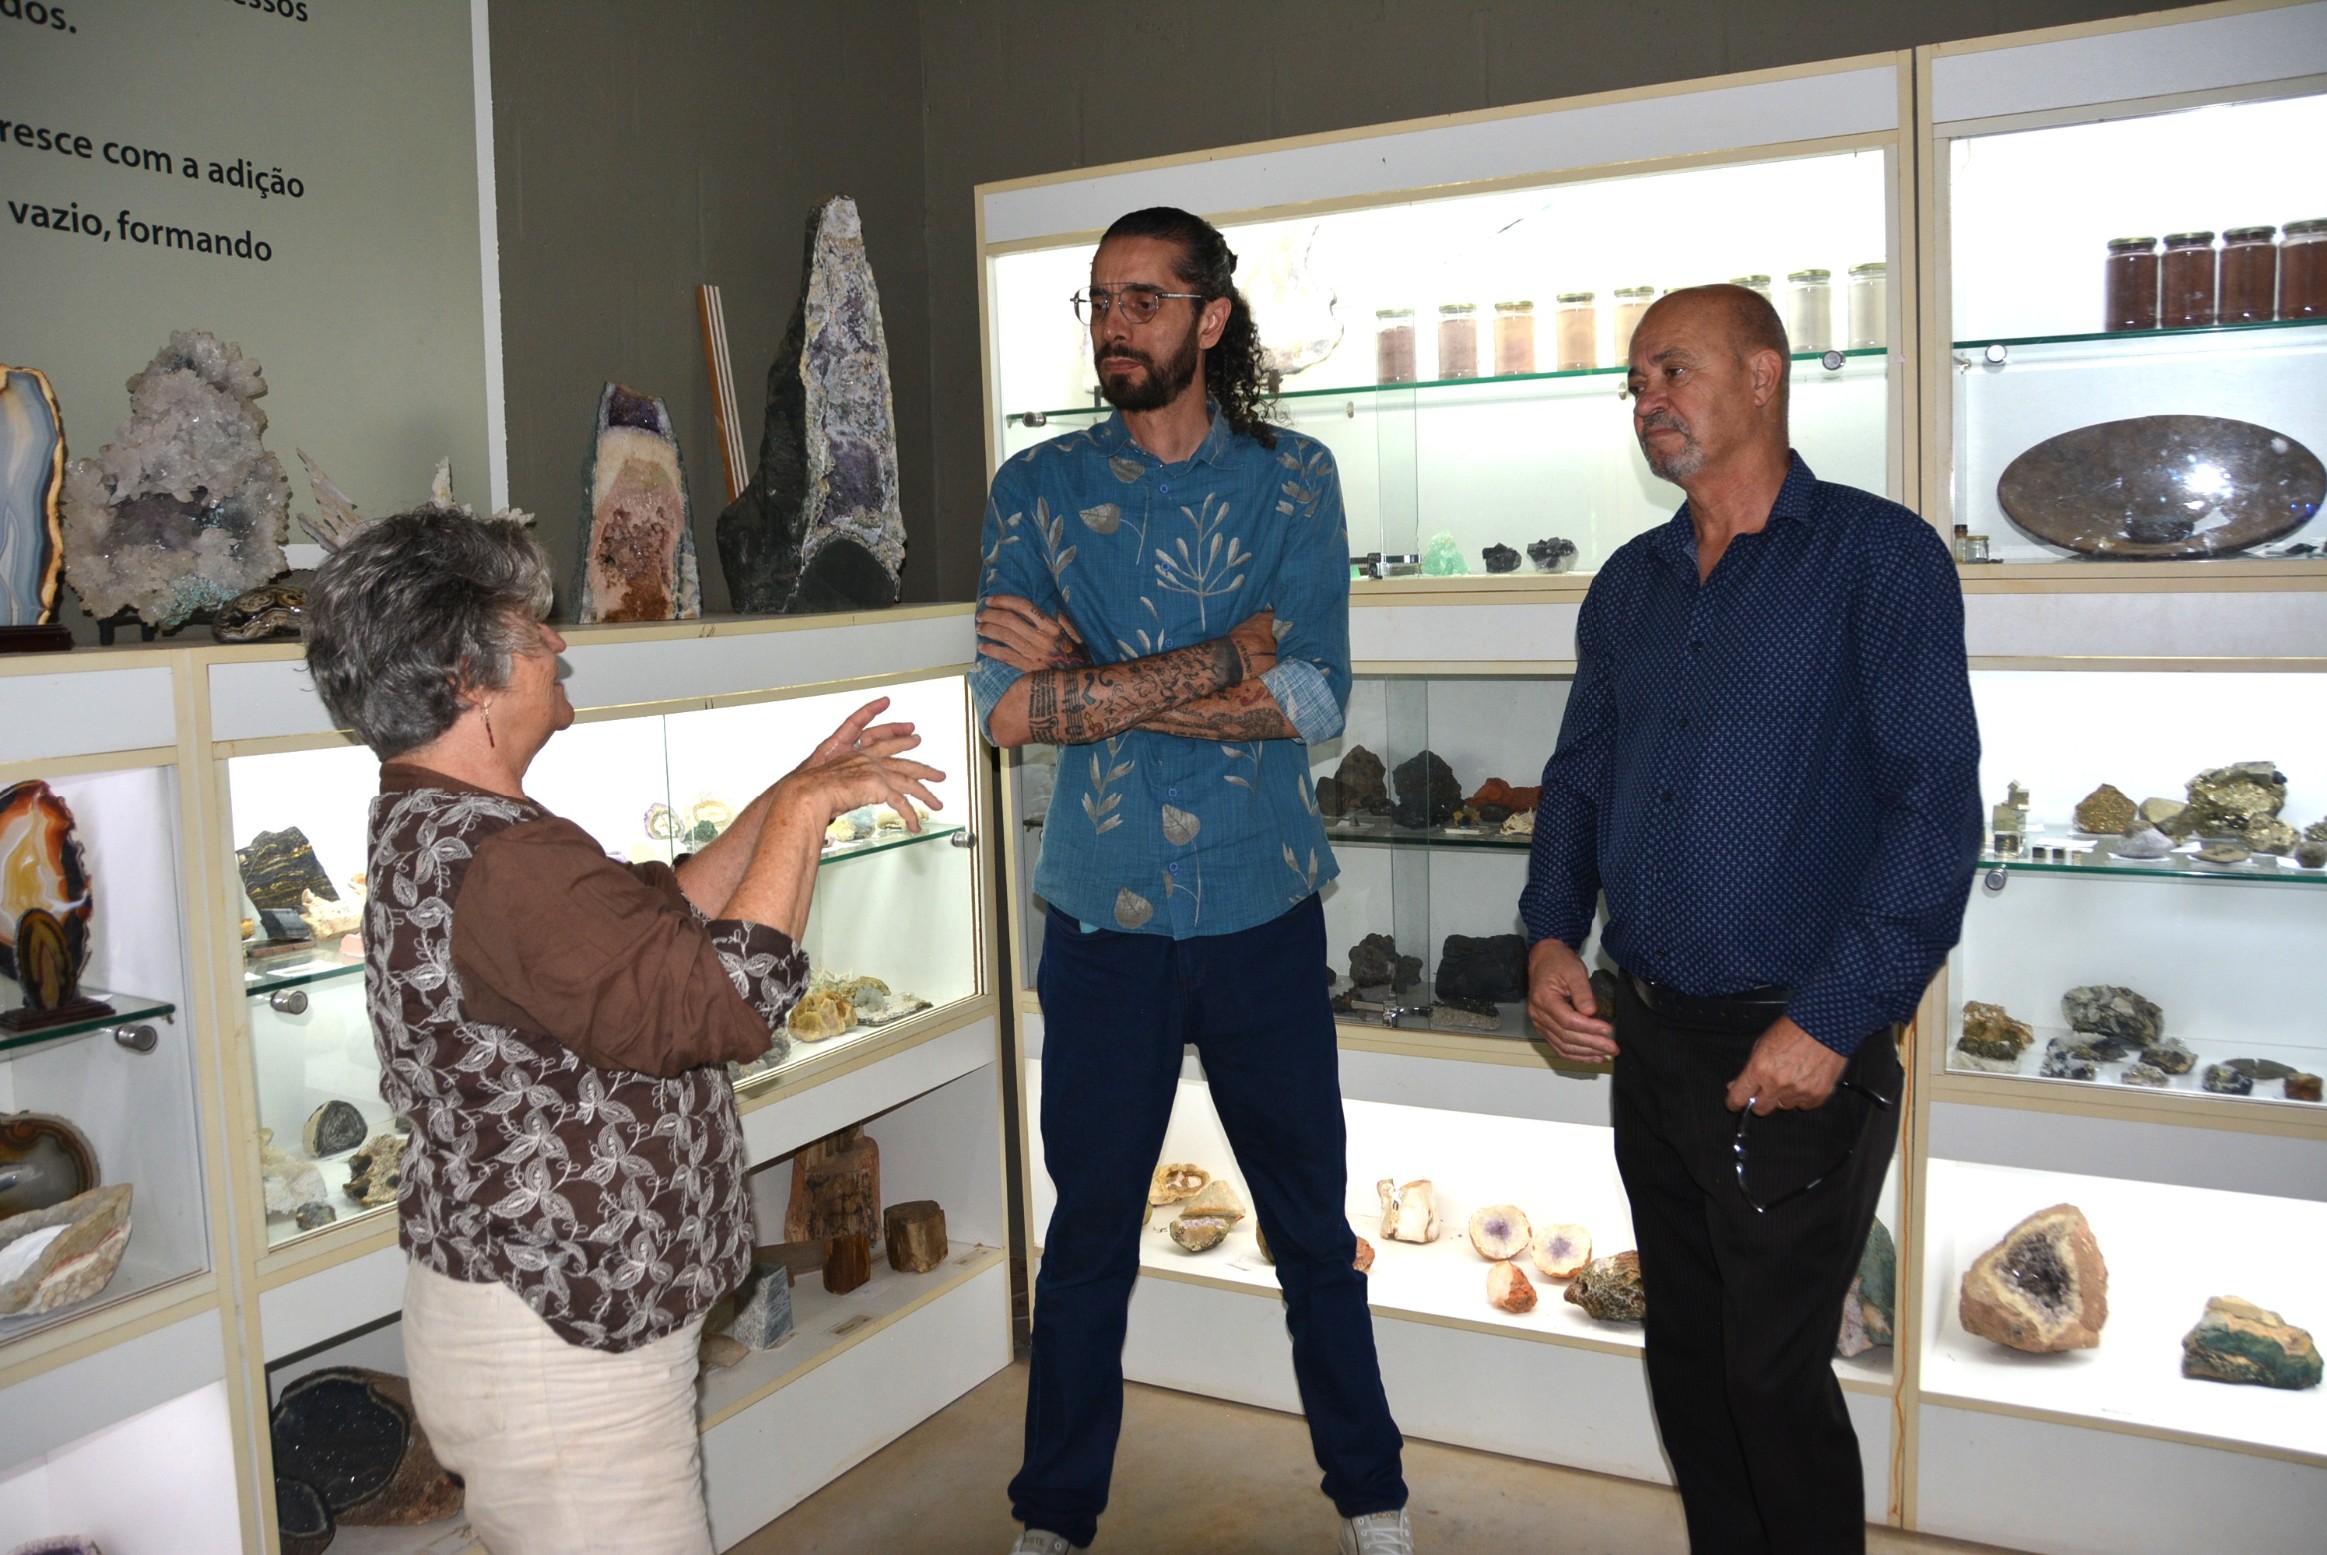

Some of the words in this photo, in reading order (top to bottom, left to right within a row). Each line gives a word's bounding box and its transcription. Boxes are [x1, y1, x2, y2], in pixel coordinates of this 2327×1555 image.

[0, 119, 93, 159] resce
[102, 142, 173, 174] com
[182, 157, 199, 179] a
[208, 158, 305, 199] adição
[7, 200, 111, 242] vazio,
[116, 209, 272, 262] formando
